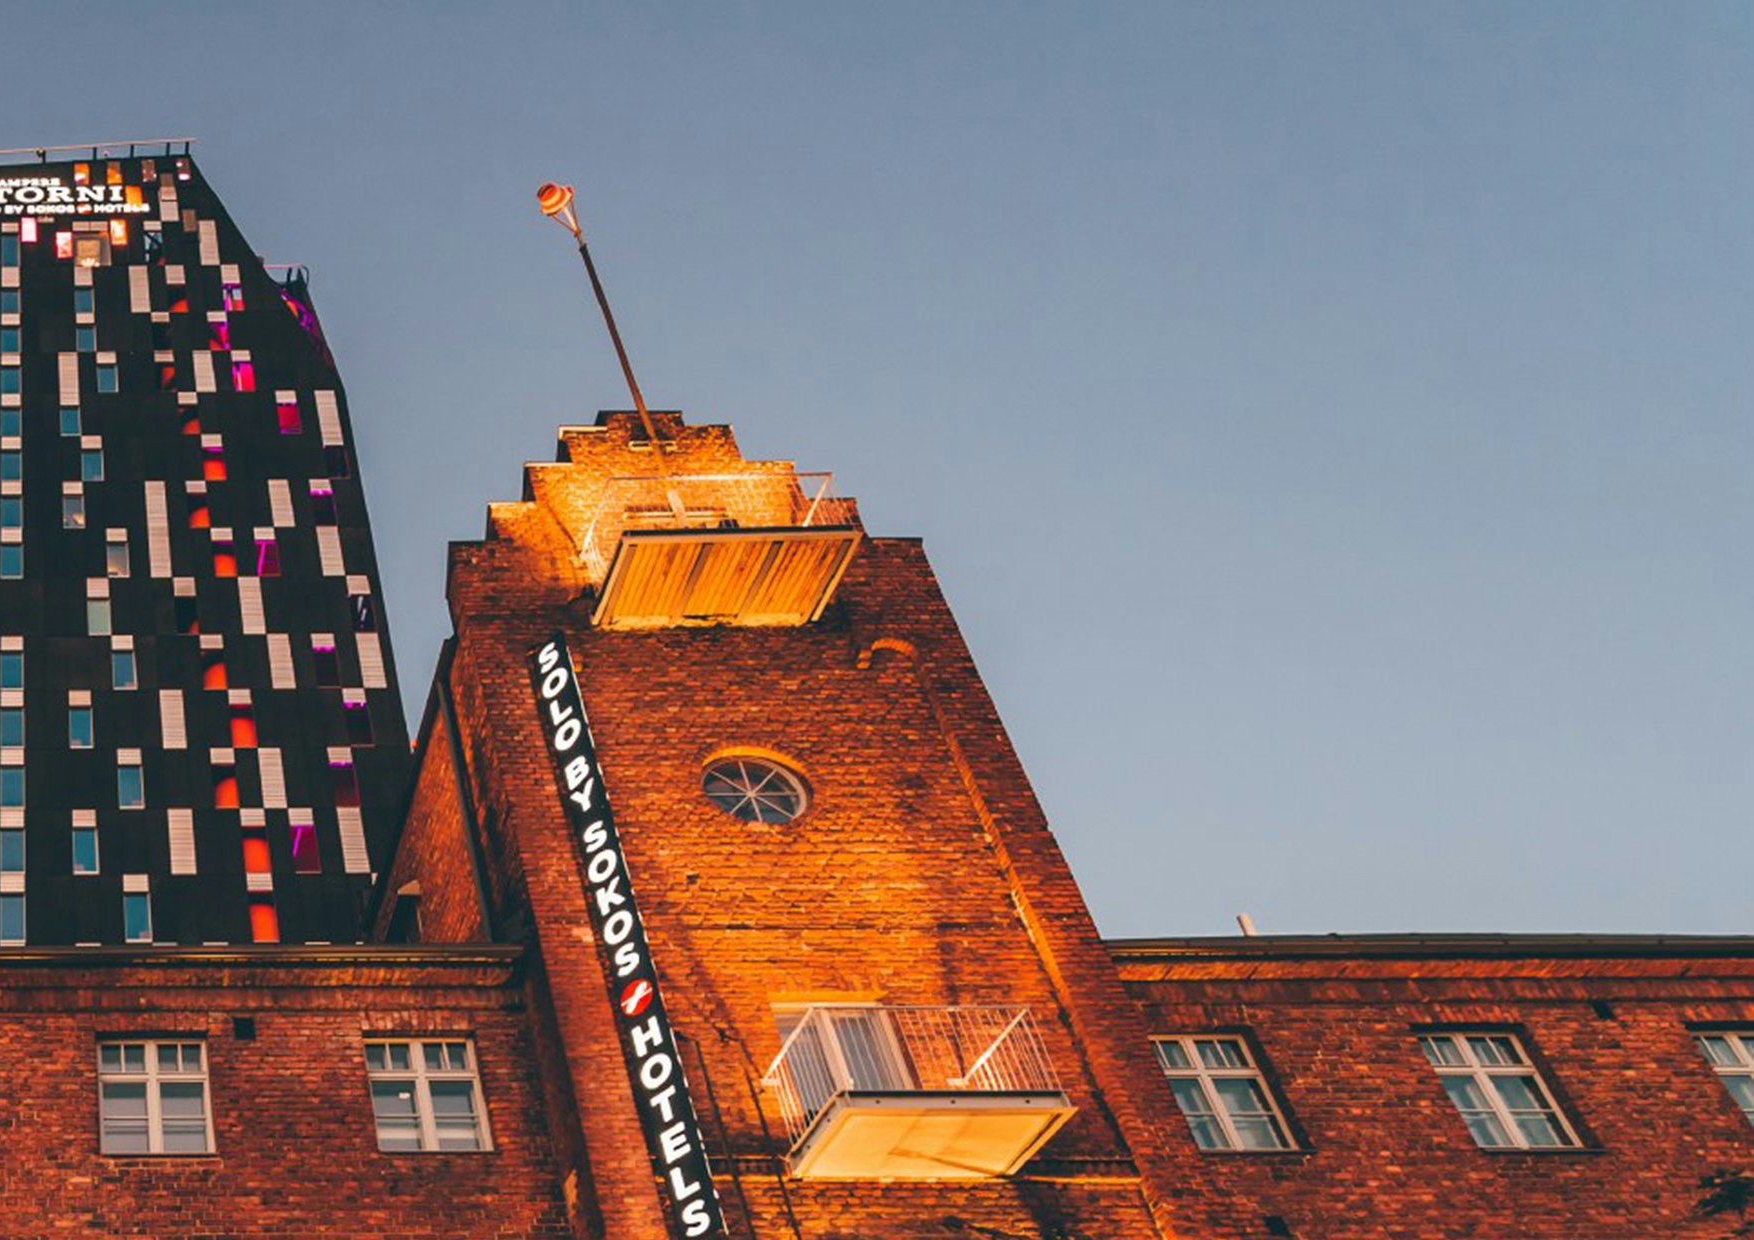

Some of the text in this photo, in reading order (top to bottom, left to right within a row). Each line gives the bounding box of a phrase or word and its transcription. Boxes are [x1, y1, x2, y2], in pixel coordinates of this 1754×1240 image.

[4, 204, 24, 214] BY
[26, 203, 75, 214] SOKOS
[93, 202, 150, 214] HOTELS
[538, 642, 711, 1238] SOLO BY SOKOS HOTELS
